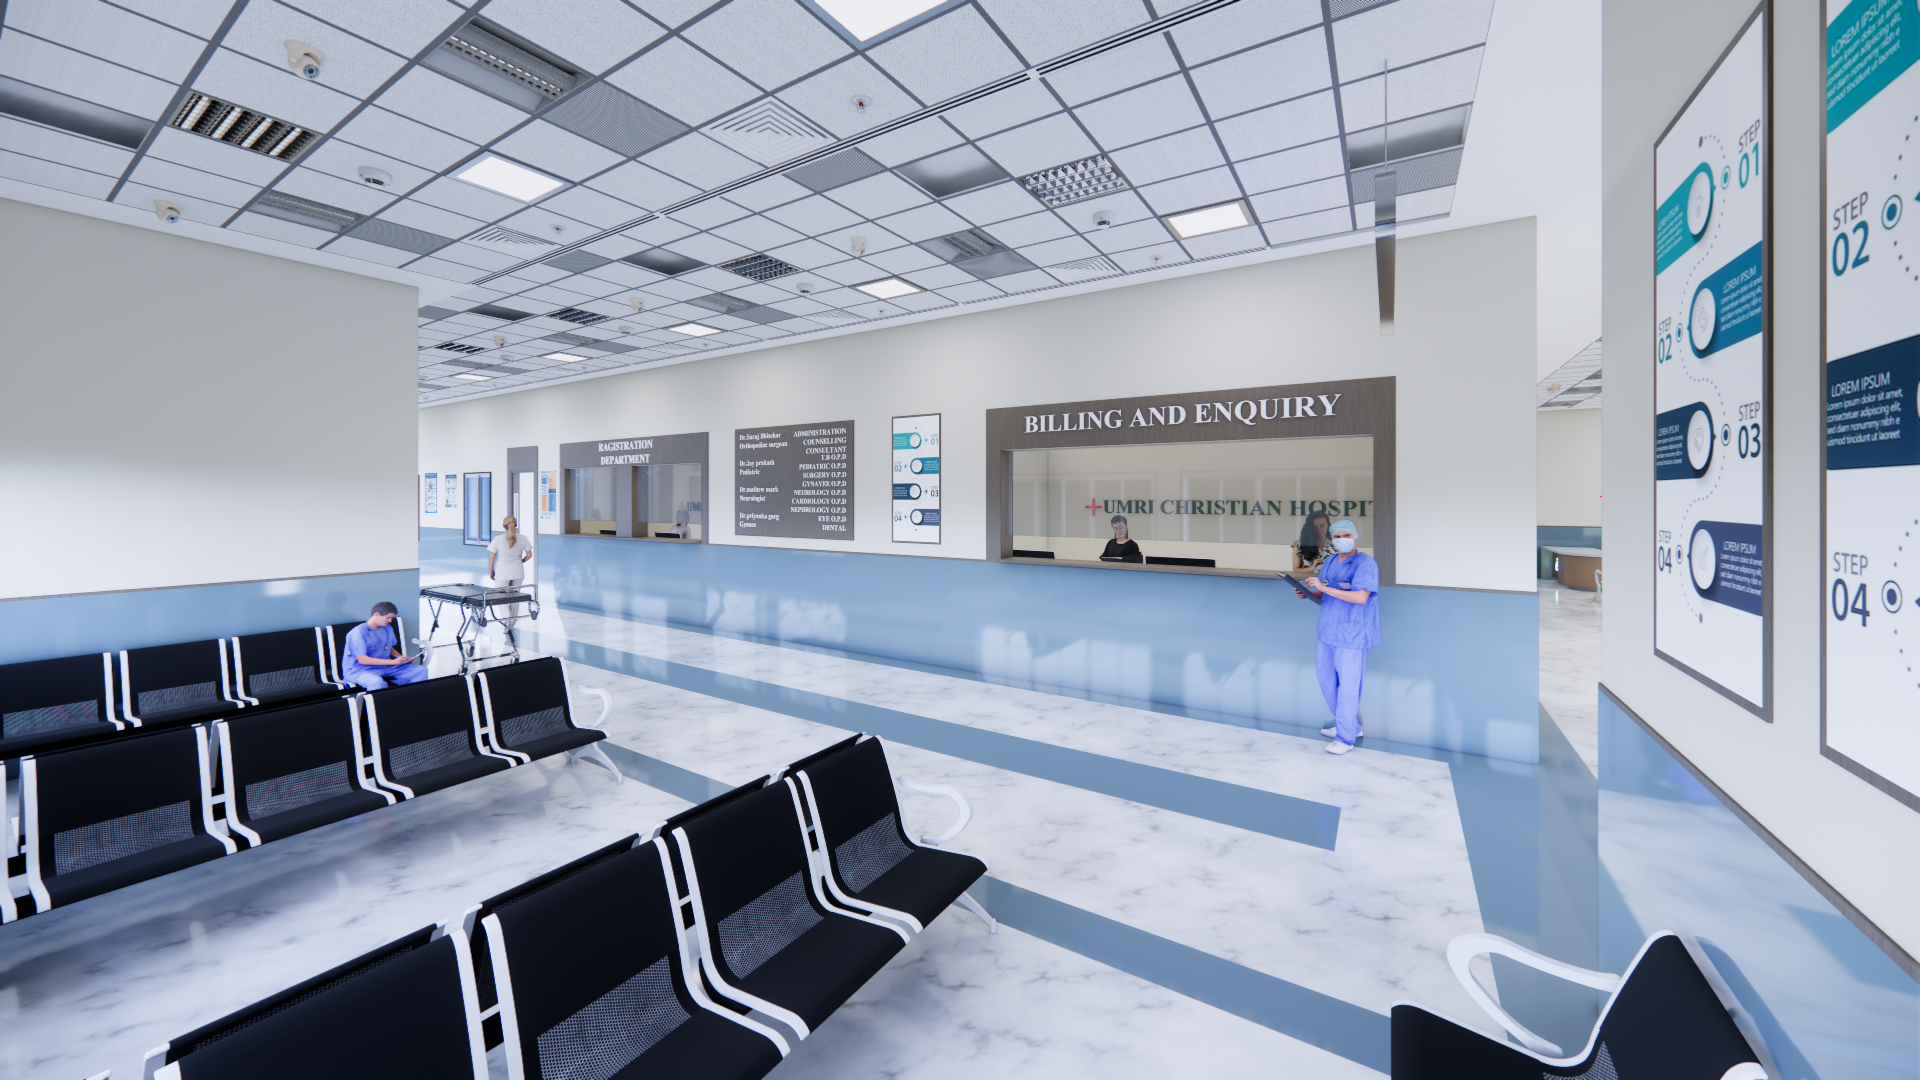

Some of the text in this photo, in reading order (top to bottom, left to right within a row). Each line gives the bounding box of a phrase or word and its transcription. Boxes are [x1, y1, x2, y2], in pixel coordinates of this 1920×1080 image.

[1831, 20, 1860, 58] LOREM
[1738, 118, 1760, 154] STEP
[1738, 141, 1760, 188] 01
[1833, 191, 1868, 231] STEP
[1832, 220, 1870, 276] 02
[1723, 265, 1756, 294] LOREM IPSUM
[1659, 316, 1672, 336] STEP
[1658, 334, 1672, 364] 02
[1831, 371, 1890, 398] LOREM IPSUM
[1844, 398, 1860, 410] ipsum
[1861, 393, 1876, 405] dolor
[1877, 390, 1885, 401] sit
[1024, 393, 1342, 434] BILLING AND ENQUIRY
[1738, 401, 1760, 422] STEP
[794, 428, 846, 438] ADMINISTRATION
[802, 436, 846, 446] COUNSELLING
[1738, 423, 1761, 459] 03
[598, 439, 654, 452] RAGISTRATION
[806, 446, 847, 454] CONSULTANT
[600, 454, 650, 466] DEPARTMENT
[894, 464, 902, 472] 02
[790, 506, 830, 514] NEPHROLOGY
[1103, 500, 1374, 517] UMRI CHRISTIAN HOSPI
[822, 524, 846, 532] DENTAL
[1659, 530, 1672, 544] STEP
[1723, 540, 1756, 555] LOREM IPSUM
[1658, 546, 1672, 574] 04
[1833, 552, 1868, 576] STEP
[1832, 578, 1870, 627] 04
